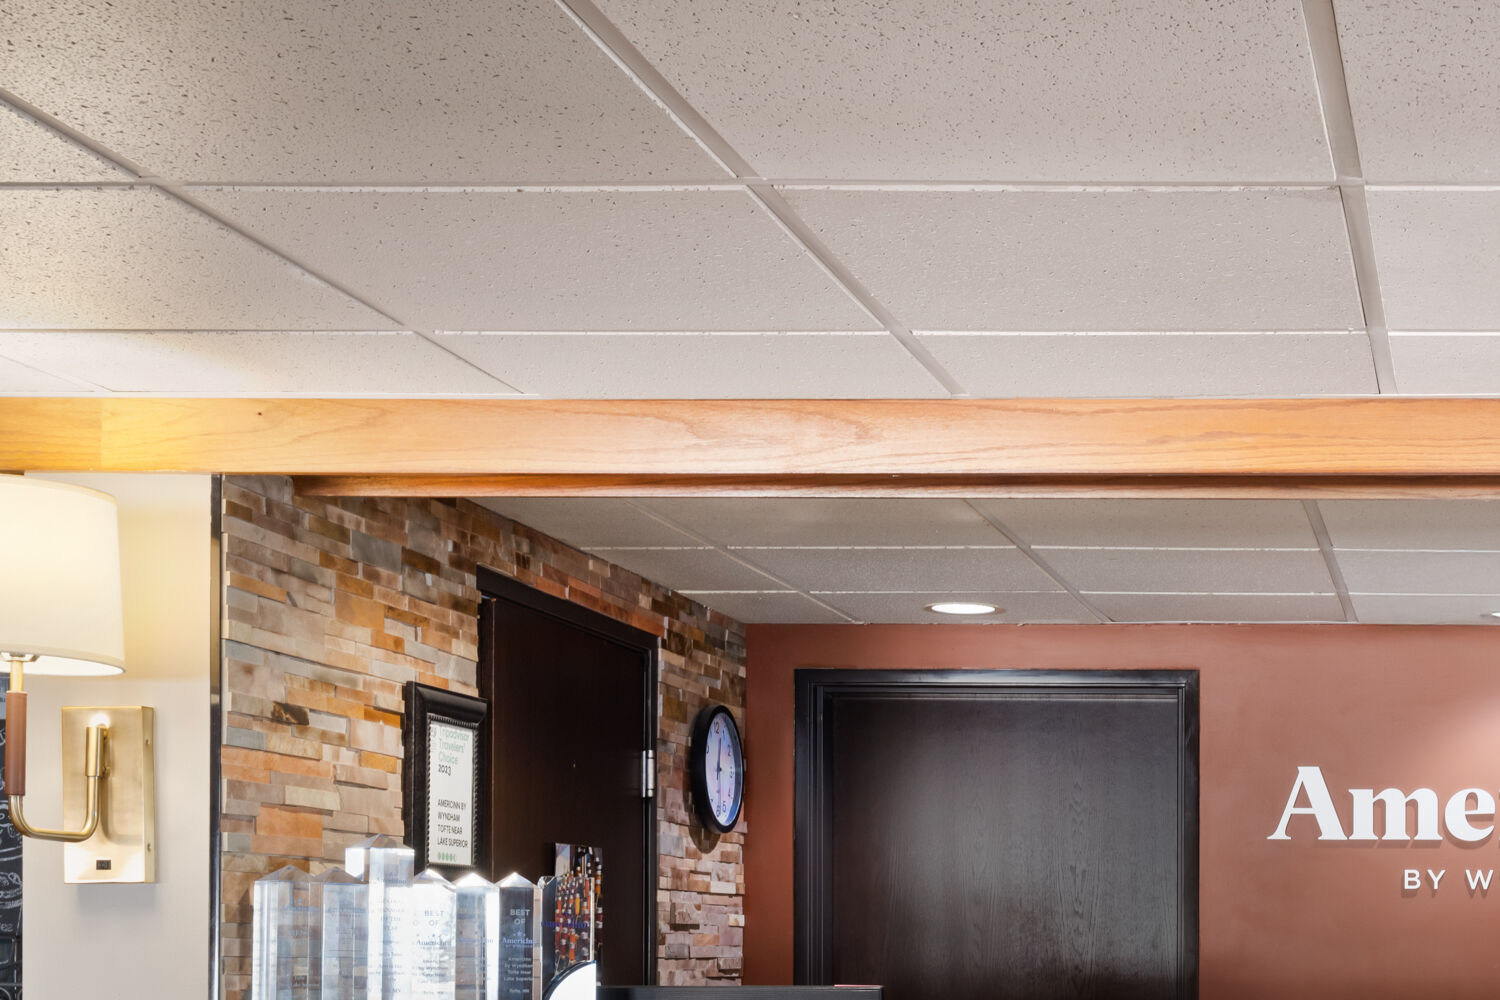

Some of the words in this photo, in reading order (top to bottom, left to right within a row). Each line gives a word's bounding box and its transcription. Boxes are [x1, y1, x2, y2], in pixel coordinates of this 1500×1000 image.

[438, 764, 452, 776] 2023
[437, 812, 461, 822] WYNDHAM
[448, 838, 469, 848] SUPERIOR
[1403, 869, 1447, 890] BY
[509, 908, 531, 917] BEST
